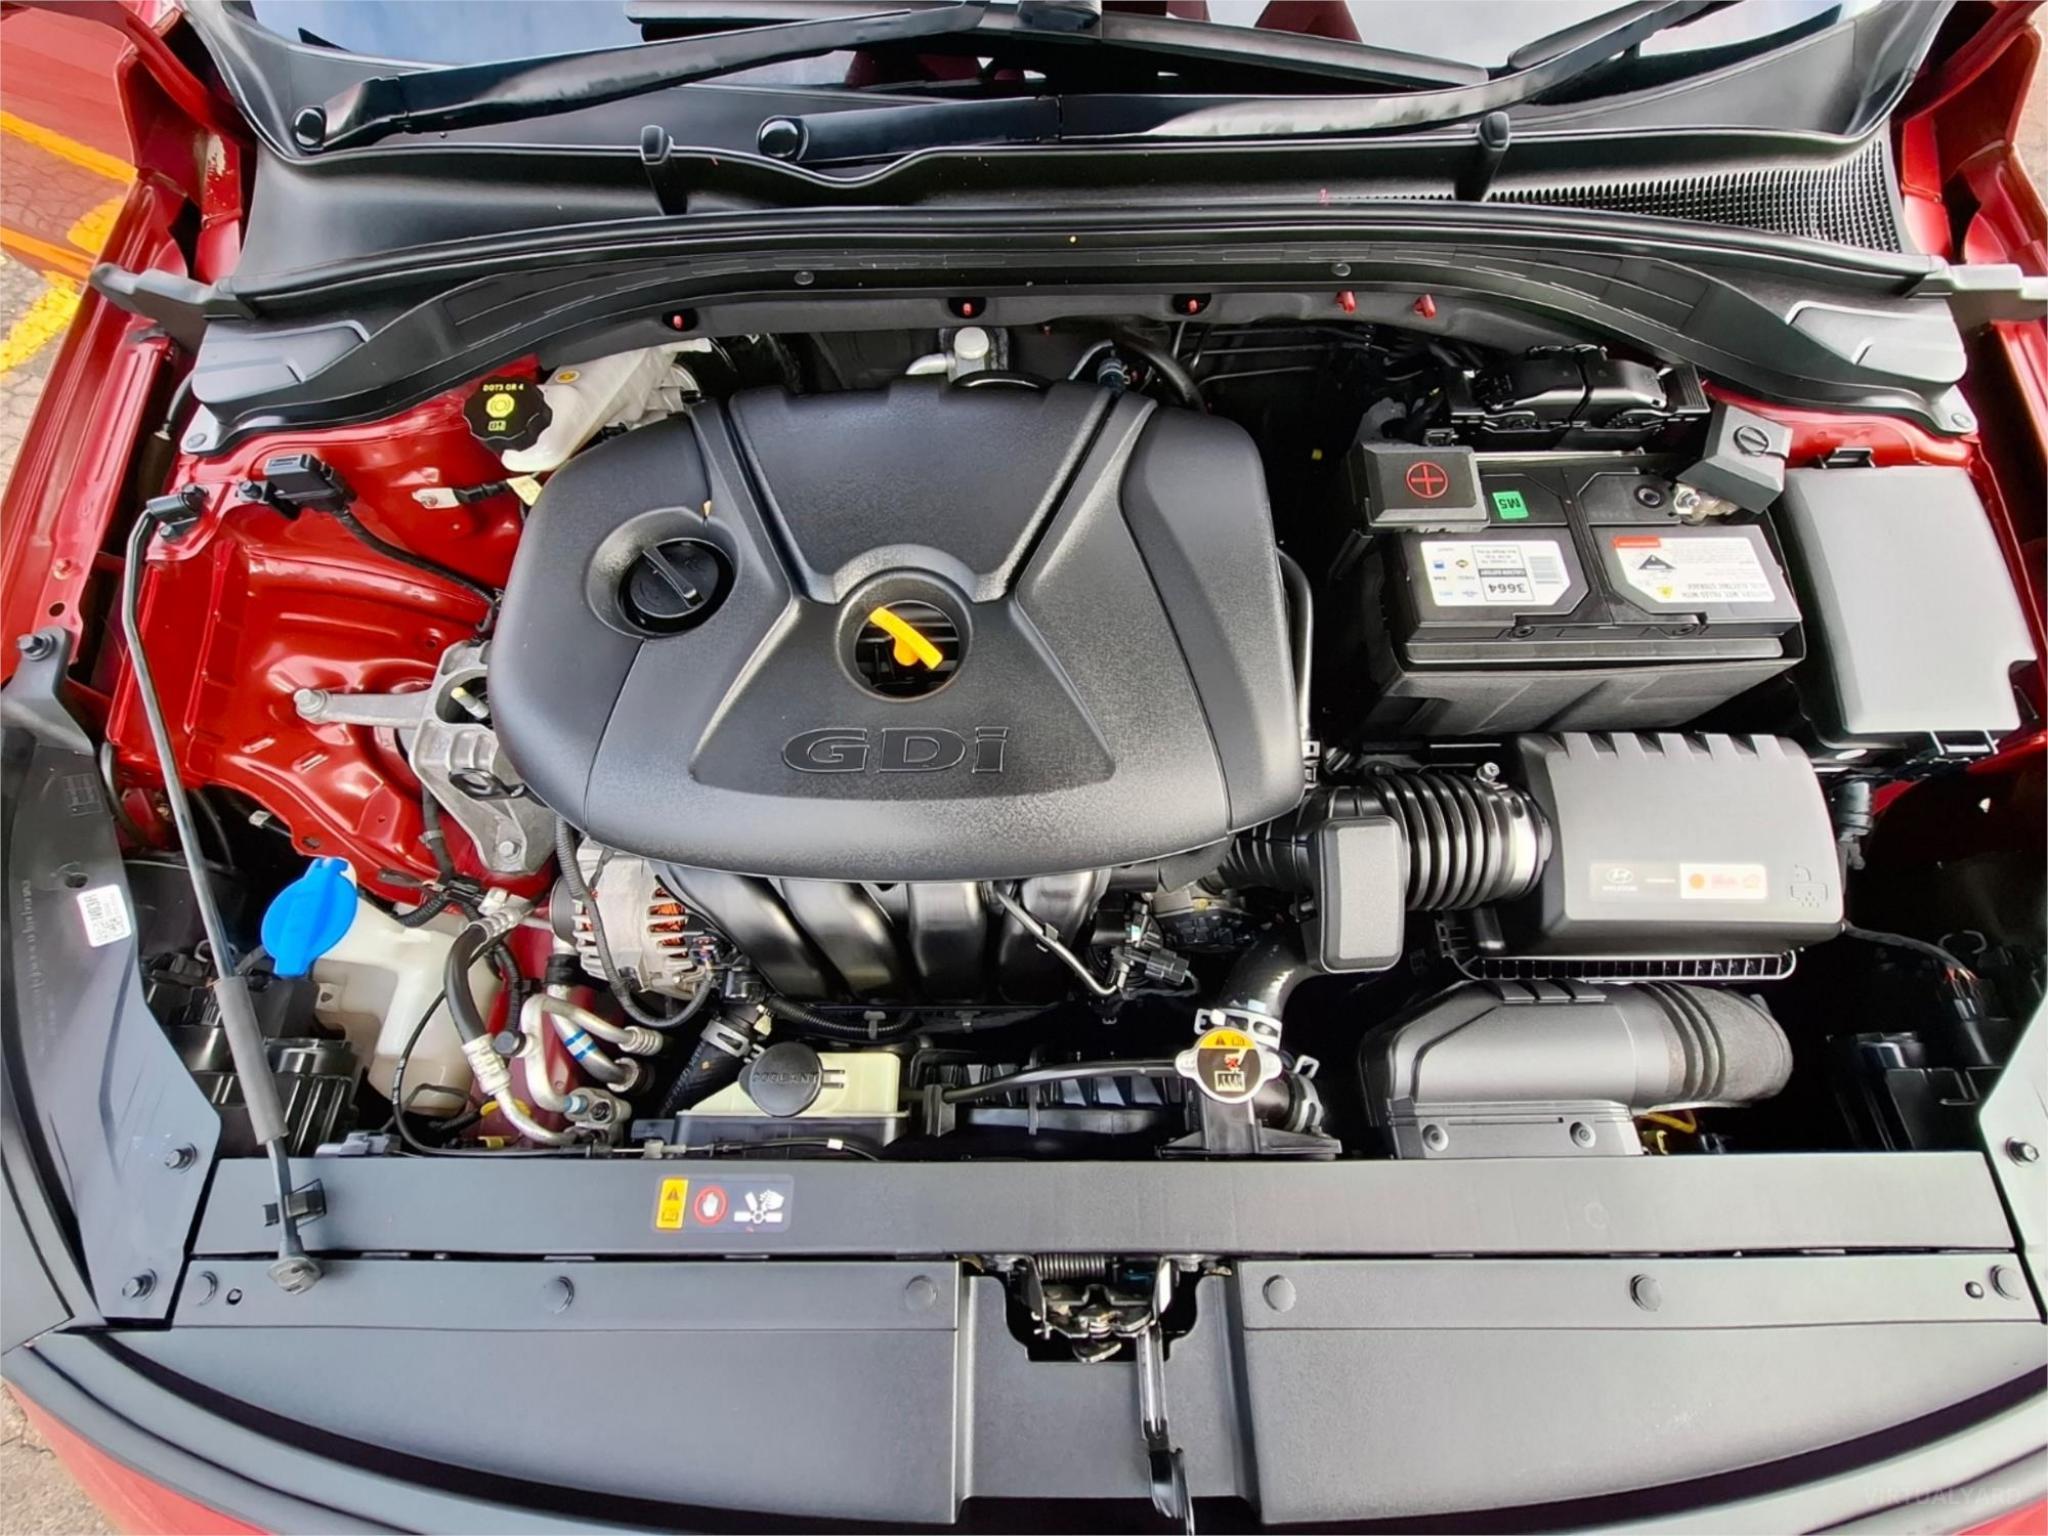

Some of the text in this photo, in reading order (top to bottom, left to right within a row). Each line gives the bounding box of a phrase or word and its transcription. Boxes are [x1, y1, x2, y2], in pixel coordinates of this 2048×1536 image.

[505, 383, 517, 391] OR
[518, 383, 524, 391] 4
[1498, 497, 1521, 509] M5
[1488, 583, 1528, 594] 3664
[782, 727, 1009, 773] GDi
